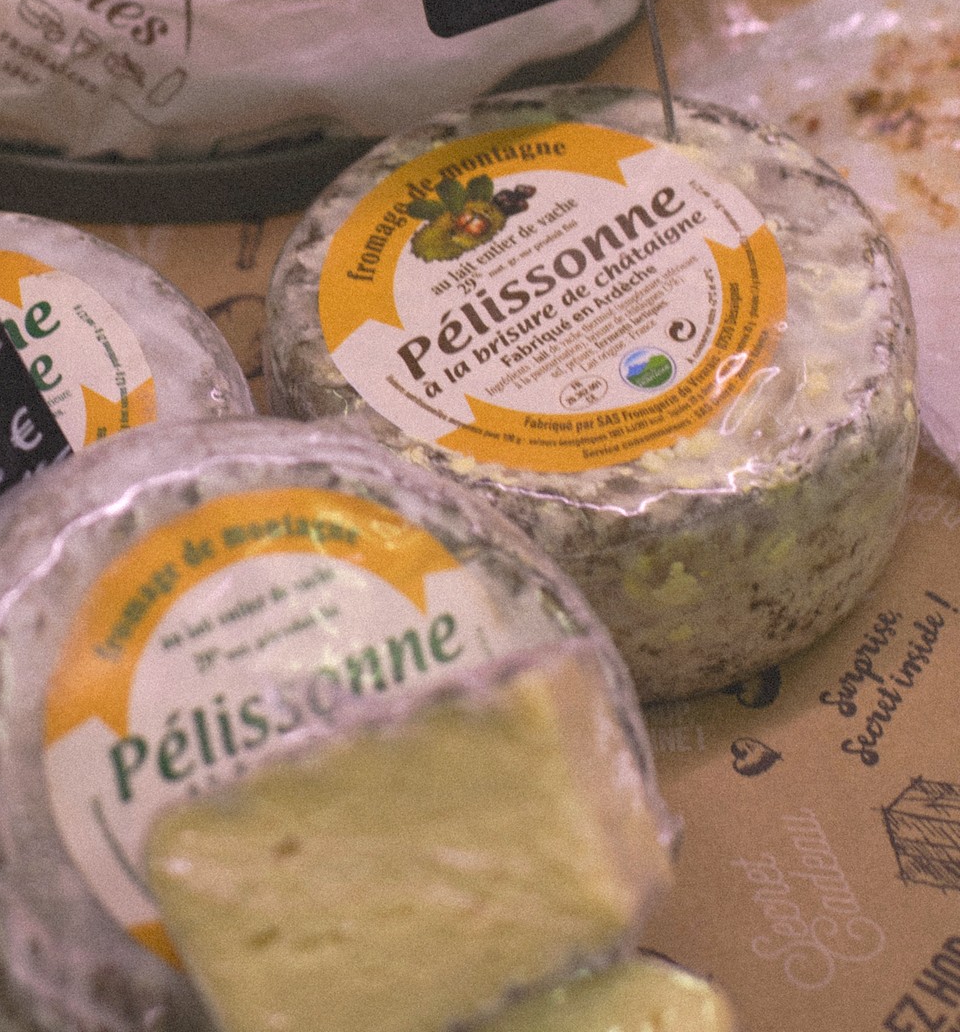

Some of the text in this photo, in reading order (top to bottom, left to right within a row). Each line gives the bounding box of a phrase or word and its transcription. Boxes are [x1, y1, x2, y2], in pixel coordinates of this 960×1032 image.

[348, 139, 567, 283] fromage de montagne
[397, 186, 685, 379] Pélissonne
[431, 194, 577, 296] au lait entier de vache
[423, 379, 443, 399] à
[446, 358, 471, 384] la
[475, 312, 556, 364] brisure
[559, 283, 591, 309] de
[594, 208, 706, 289] châtaigne
[501, 320, 576, 368] Fabriqué
[573, 300, 595, 324] en
[593, 264, 657, 311] Ardèche
[523, 415, 573, 433] Fabriqué
[575, 419, 595, 433] par
[597, 413, 621, 428] SAS
[622, 397, 680, 424] Fromagerie
[108, 612, 464, 803] Pélissonne
[820, 609, 903, 718] Surprise,
[841, 686, 903, 767] Secret
[896, 614, 949, 693] inside
[783, 807, 885, 962] Cadeau
